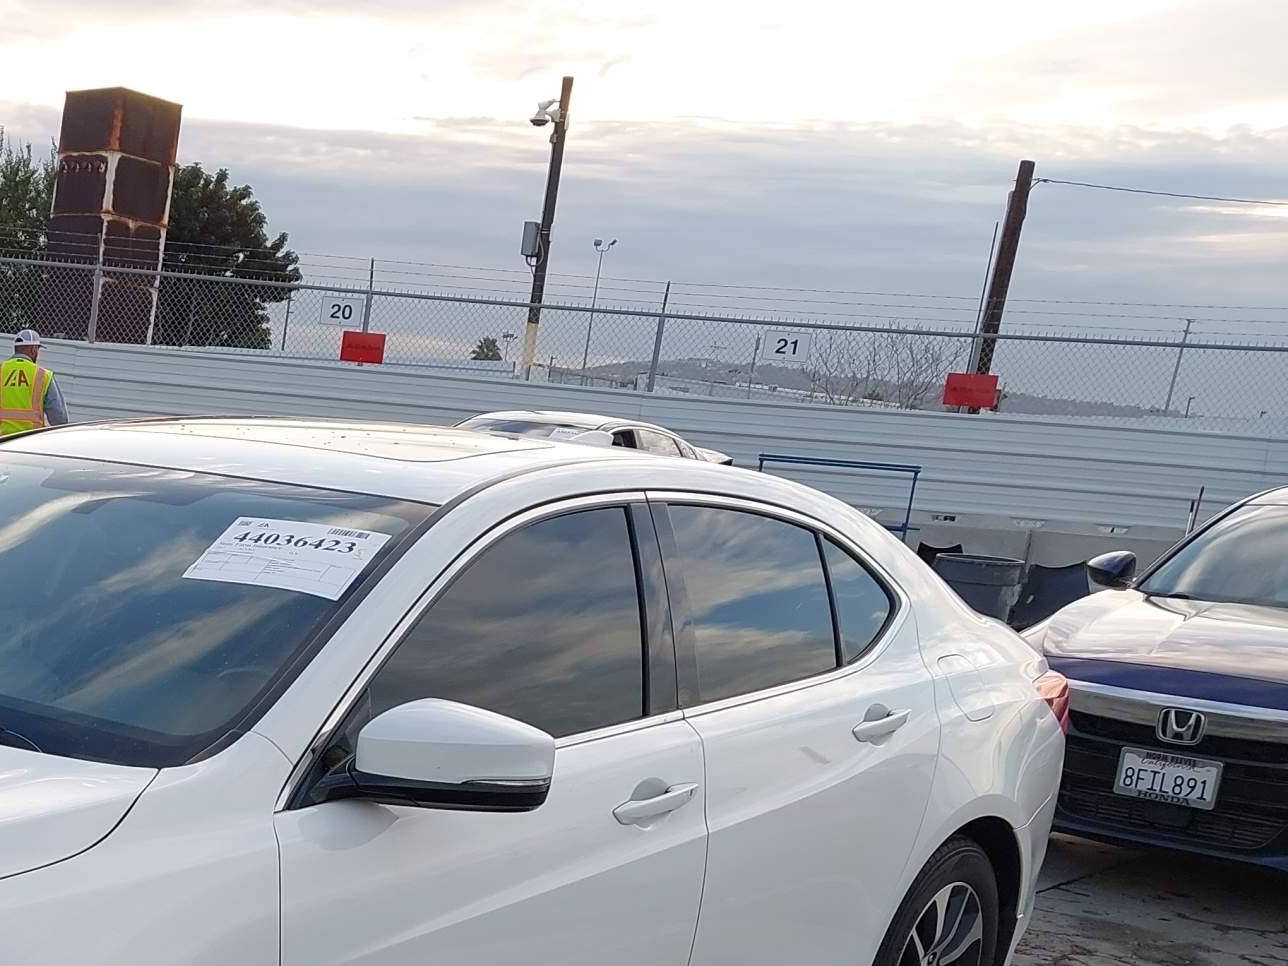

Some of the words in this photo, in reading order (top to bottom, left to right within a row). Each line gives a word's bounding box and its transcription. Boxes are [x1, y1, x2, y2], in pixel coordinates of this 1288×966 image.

[329, 303, 353, 320] 20
[775, 338, 799, 355] 21
[233, 530, 357, 554] 44036423
[1123, 766, 1207, 801] 8FIL891
[1137, 789, 1190, 805] HONDA
